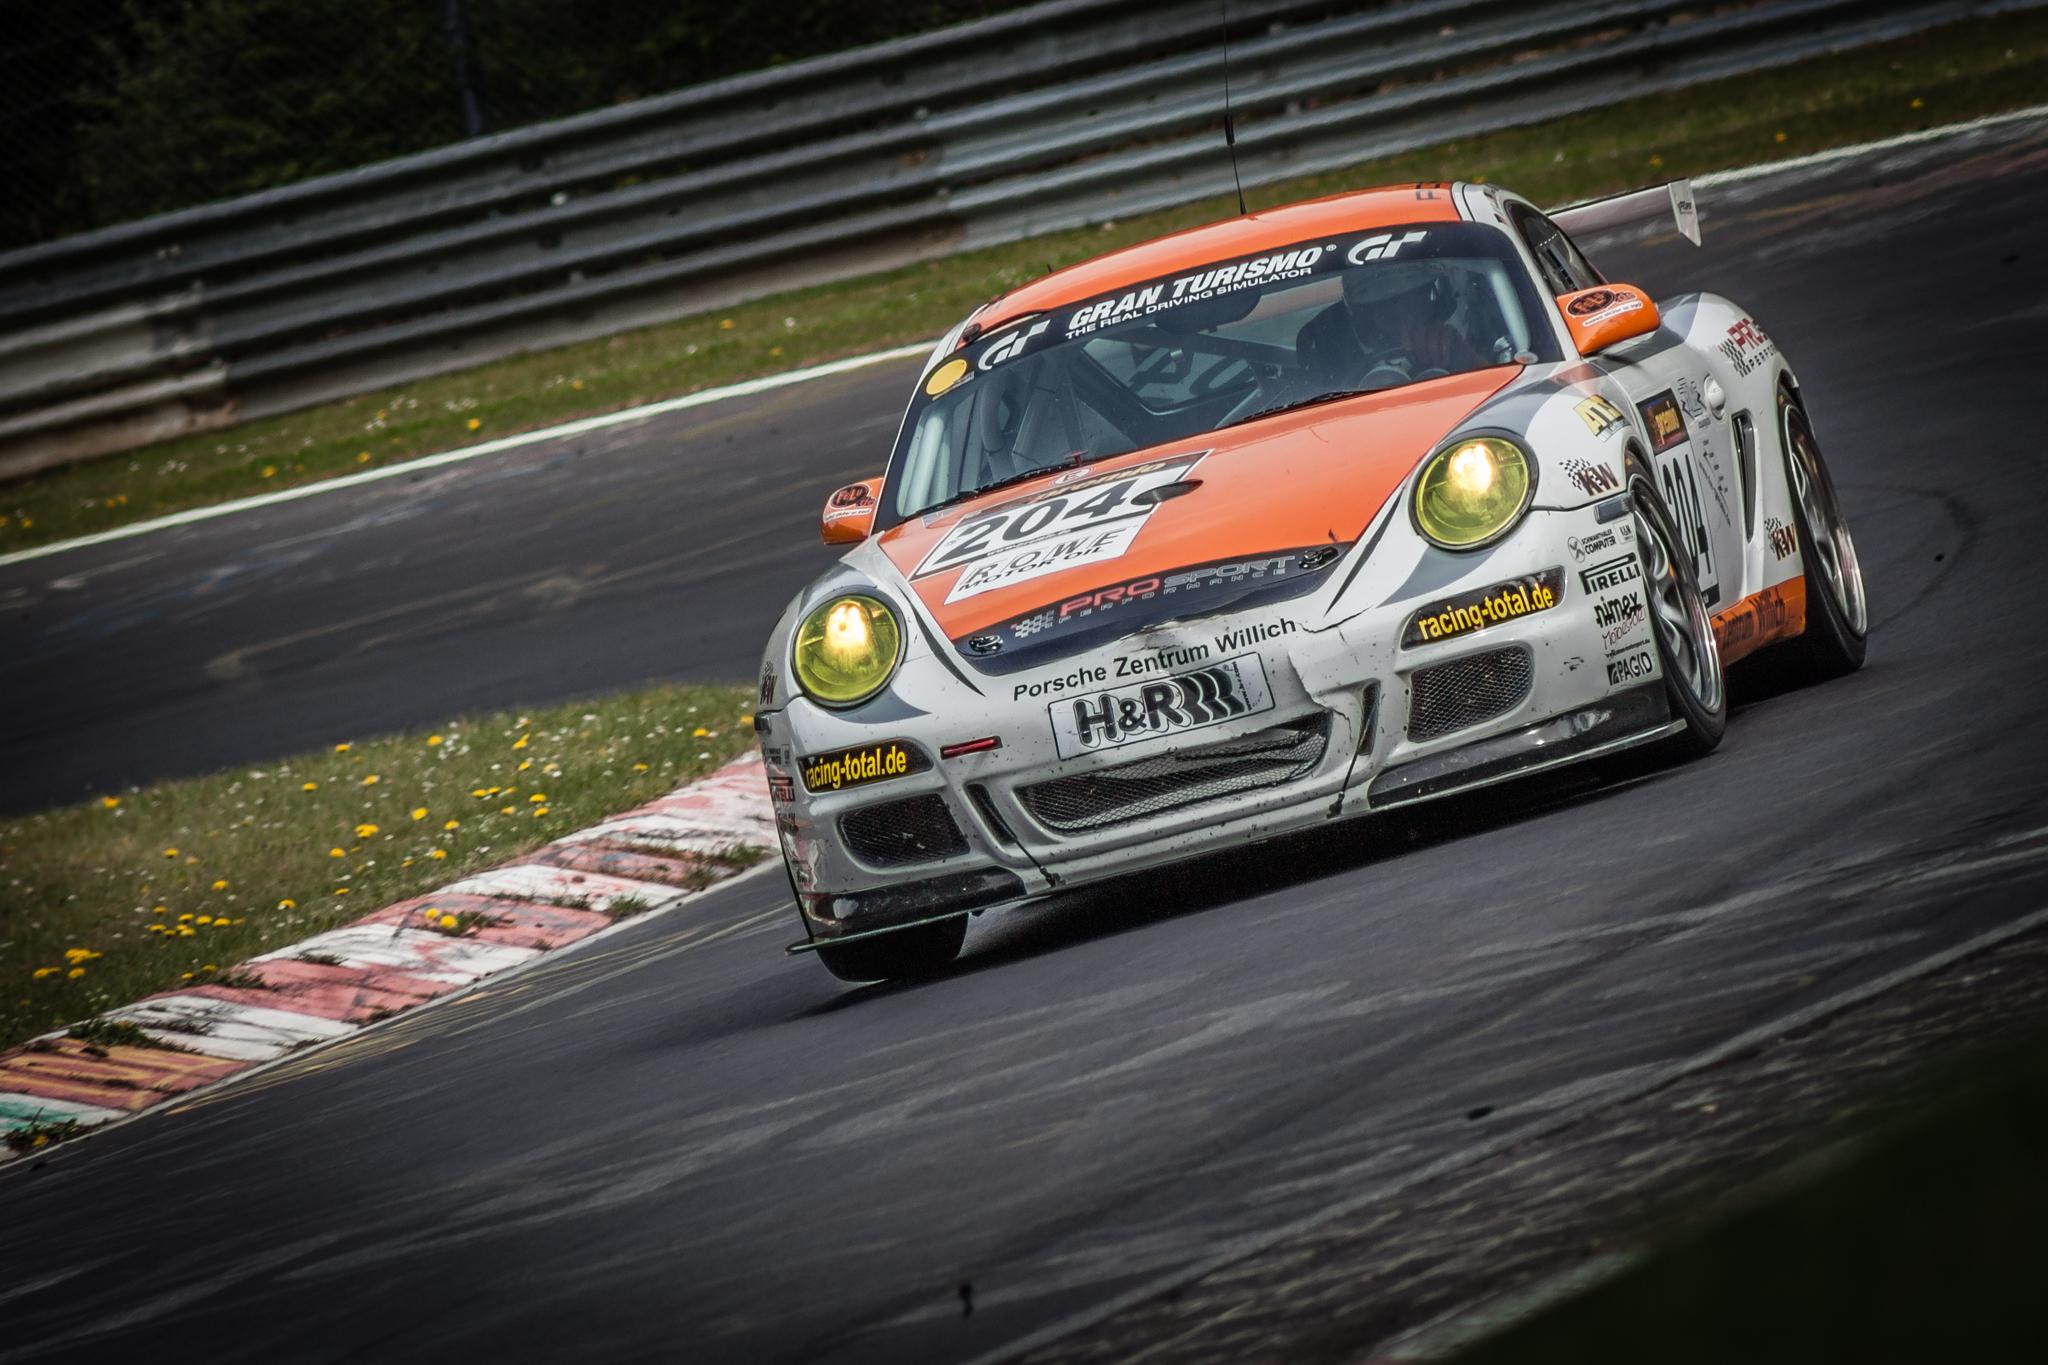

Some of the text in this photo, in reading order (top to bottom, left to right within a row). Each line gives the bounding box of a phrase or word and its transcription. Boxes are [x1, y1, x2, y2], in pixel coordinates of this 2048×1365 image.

[1064, 266, 1312, 340] THE REAL DRIVING SIMULATOR
[1068, 246, 1323, 330] GRAN TURISMO
[931, 478, 1139, 566] 204
[1584, 535, 1617, 555] COMPUTER
[957, 546, 1105, 592] MOTOR OIL
[964, 526, 1130, 585] ROWE
[1578, 551, 1642, 596] PIRELLI
[1418, 582, 1554, 641] racing-total.de
[1013, 617, 1297, 701] Porsche Zentrum Willich
[1612, 651, 1653, 683] PAGID
[1072, 682, 1197, 749] H&R
[805, 745, 908, 790] racing-total.de
